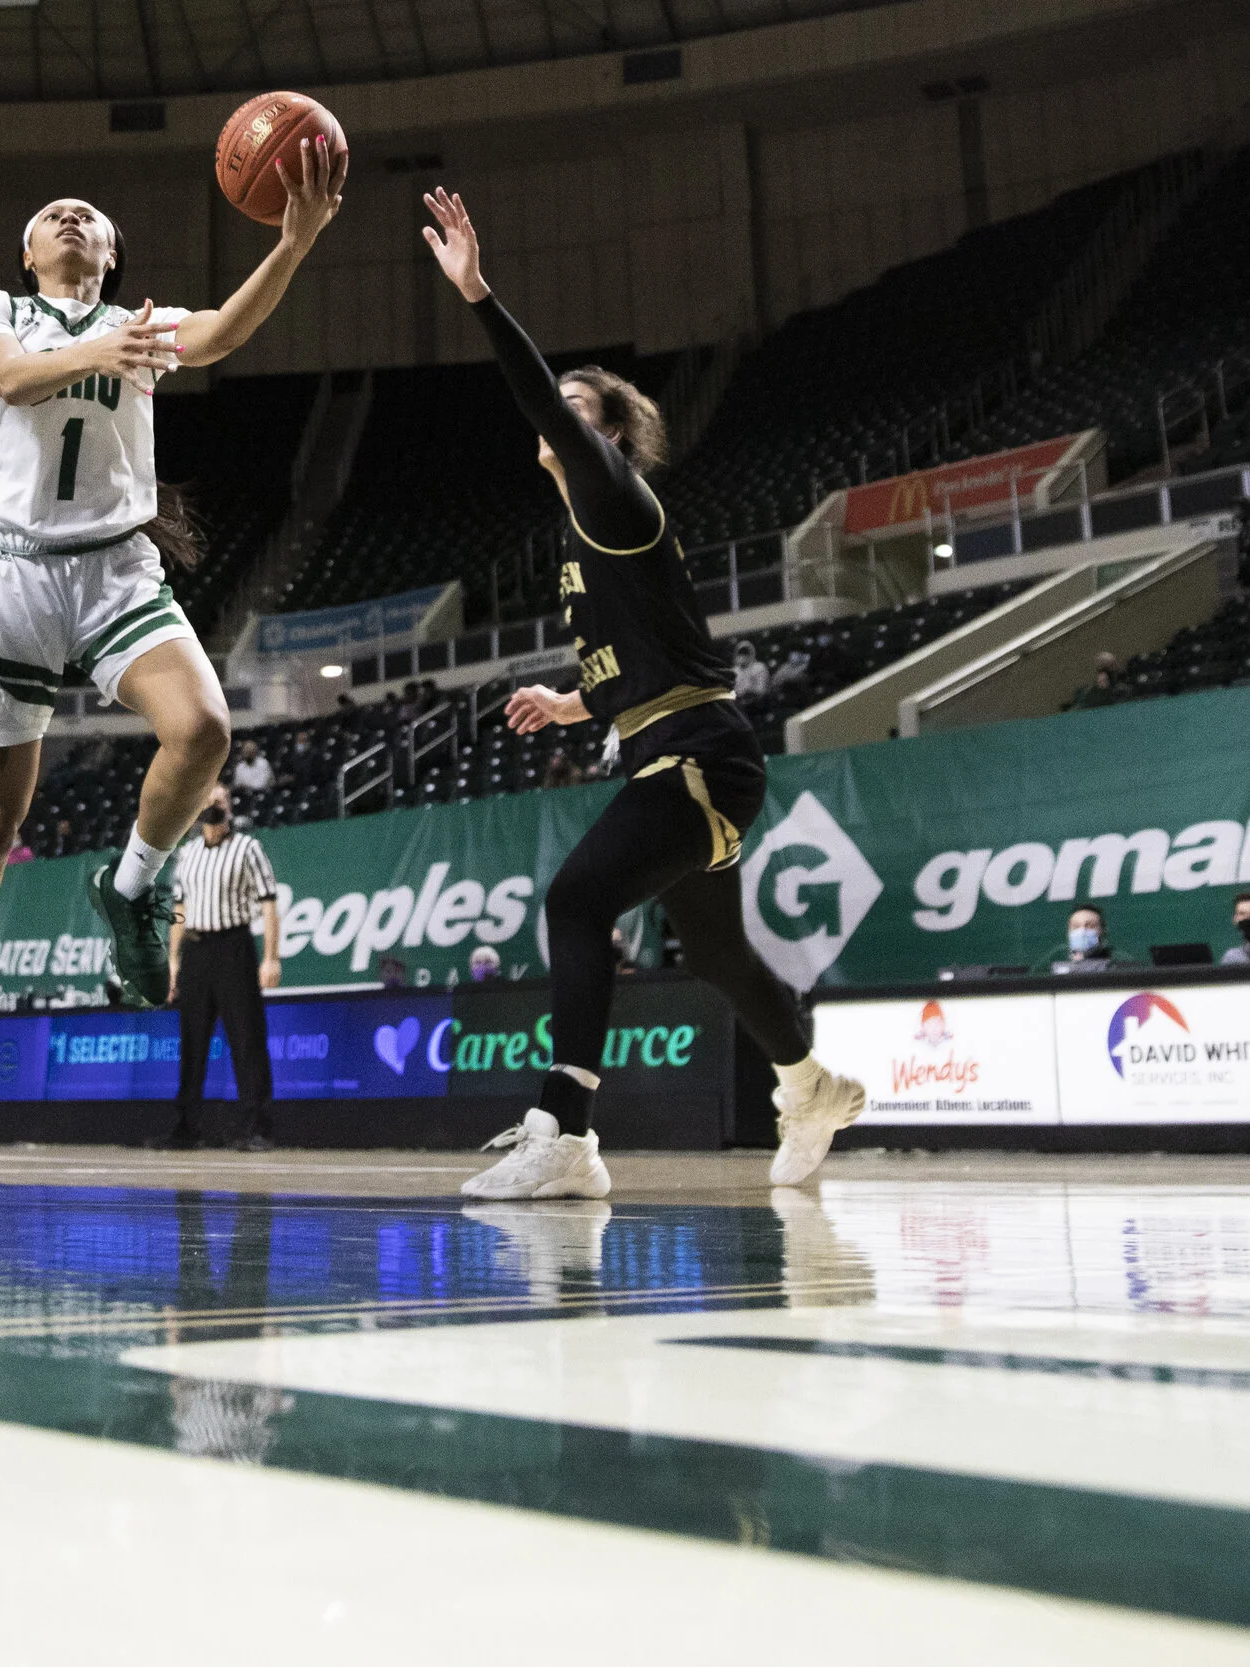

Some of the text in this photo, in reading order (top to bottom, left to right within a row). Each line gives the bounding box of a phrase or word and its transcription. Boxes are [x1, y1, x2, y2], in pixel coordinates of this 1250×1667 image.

[57, 418, 84, 501] 1
[911, 819, 1250, 932] goma
[68, 1034, 149, 1064] SELECTED
[427, 1013, 696, 1073] CareSurce
[1130, 1044, 1196, 1064] DAVID
